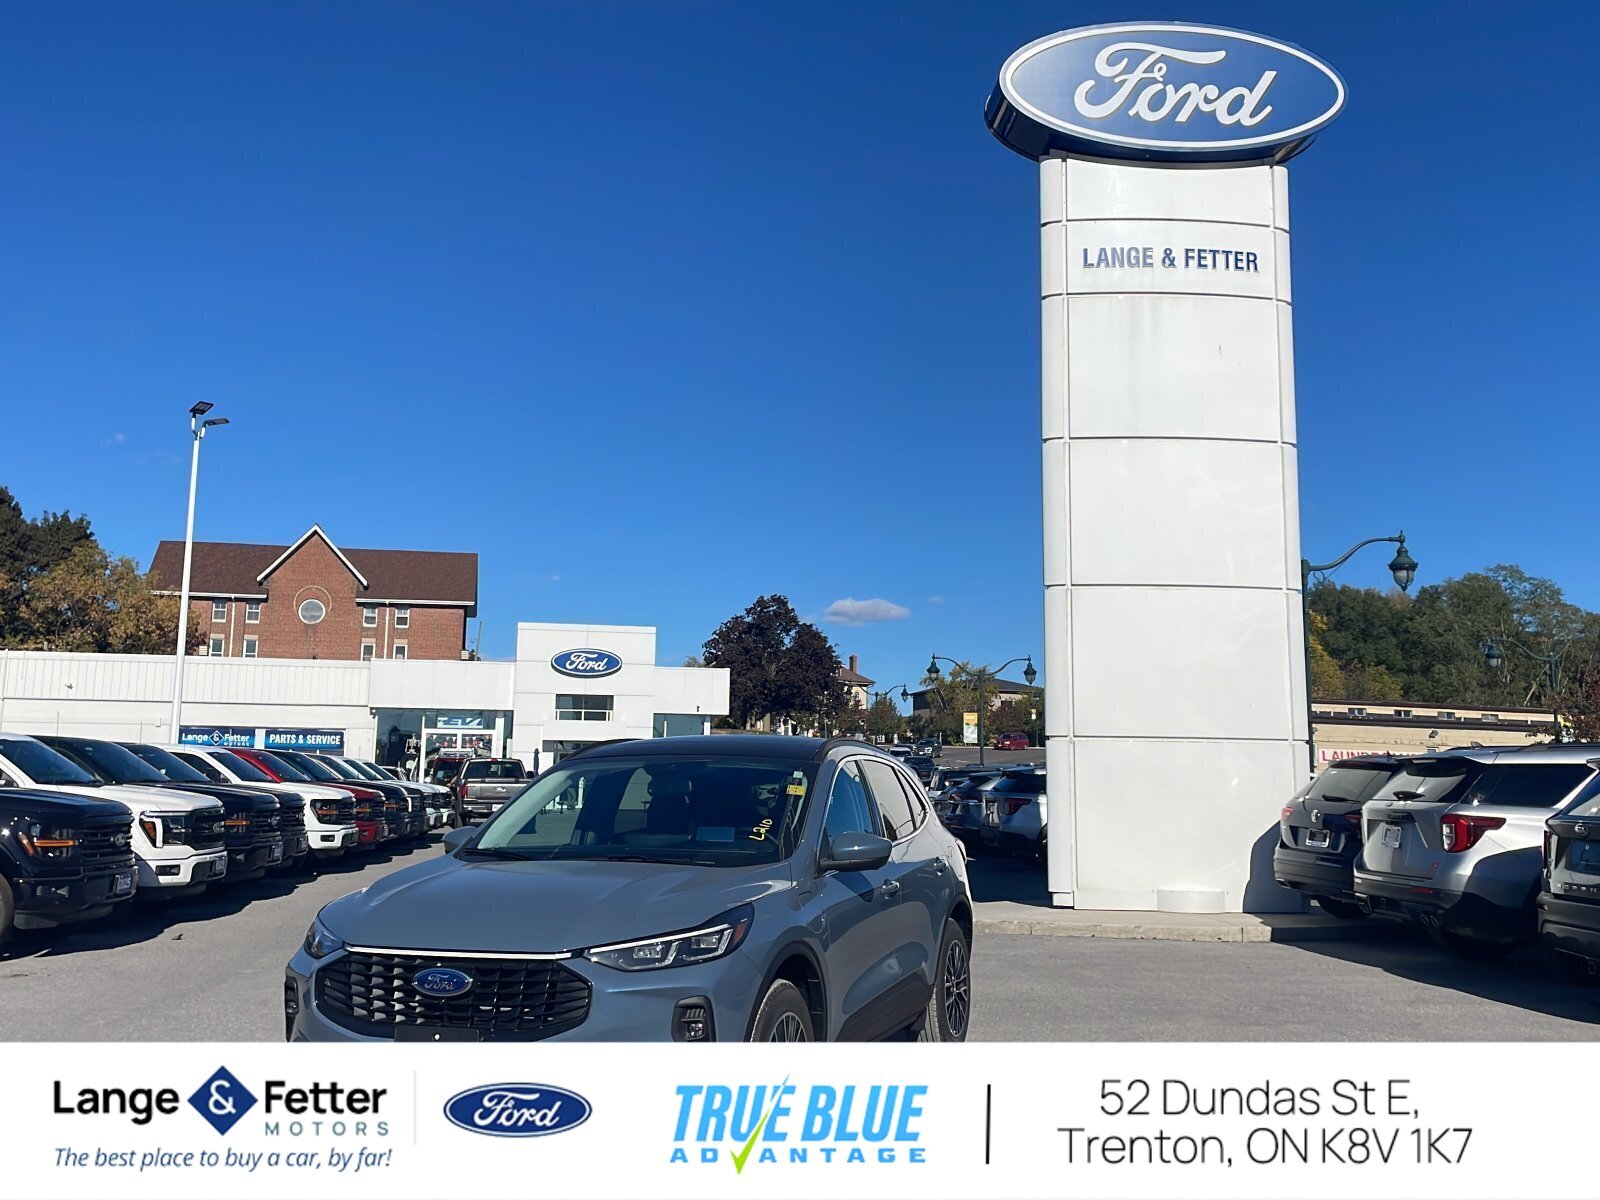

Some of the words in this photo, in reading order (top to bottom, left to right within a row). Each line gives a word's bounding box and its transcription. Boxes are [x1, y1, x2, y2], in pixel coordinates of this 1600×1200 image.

[1074, 42, 1278, 127] Ford
[1082, 247, 1154, 269] LANGE
[1161, 248, 1177, 268] &
[1184, 248, 1260, 273] FETTER
[565, 652, 609, 671] Ford
[182, 733, 208, 743] Lange
[224, 733, 250, 742] Fetter
[269, 734, 296, 744] PARTS
[298, 734, 304, 744] &
[306, 735, 341, 745] SERVICE
